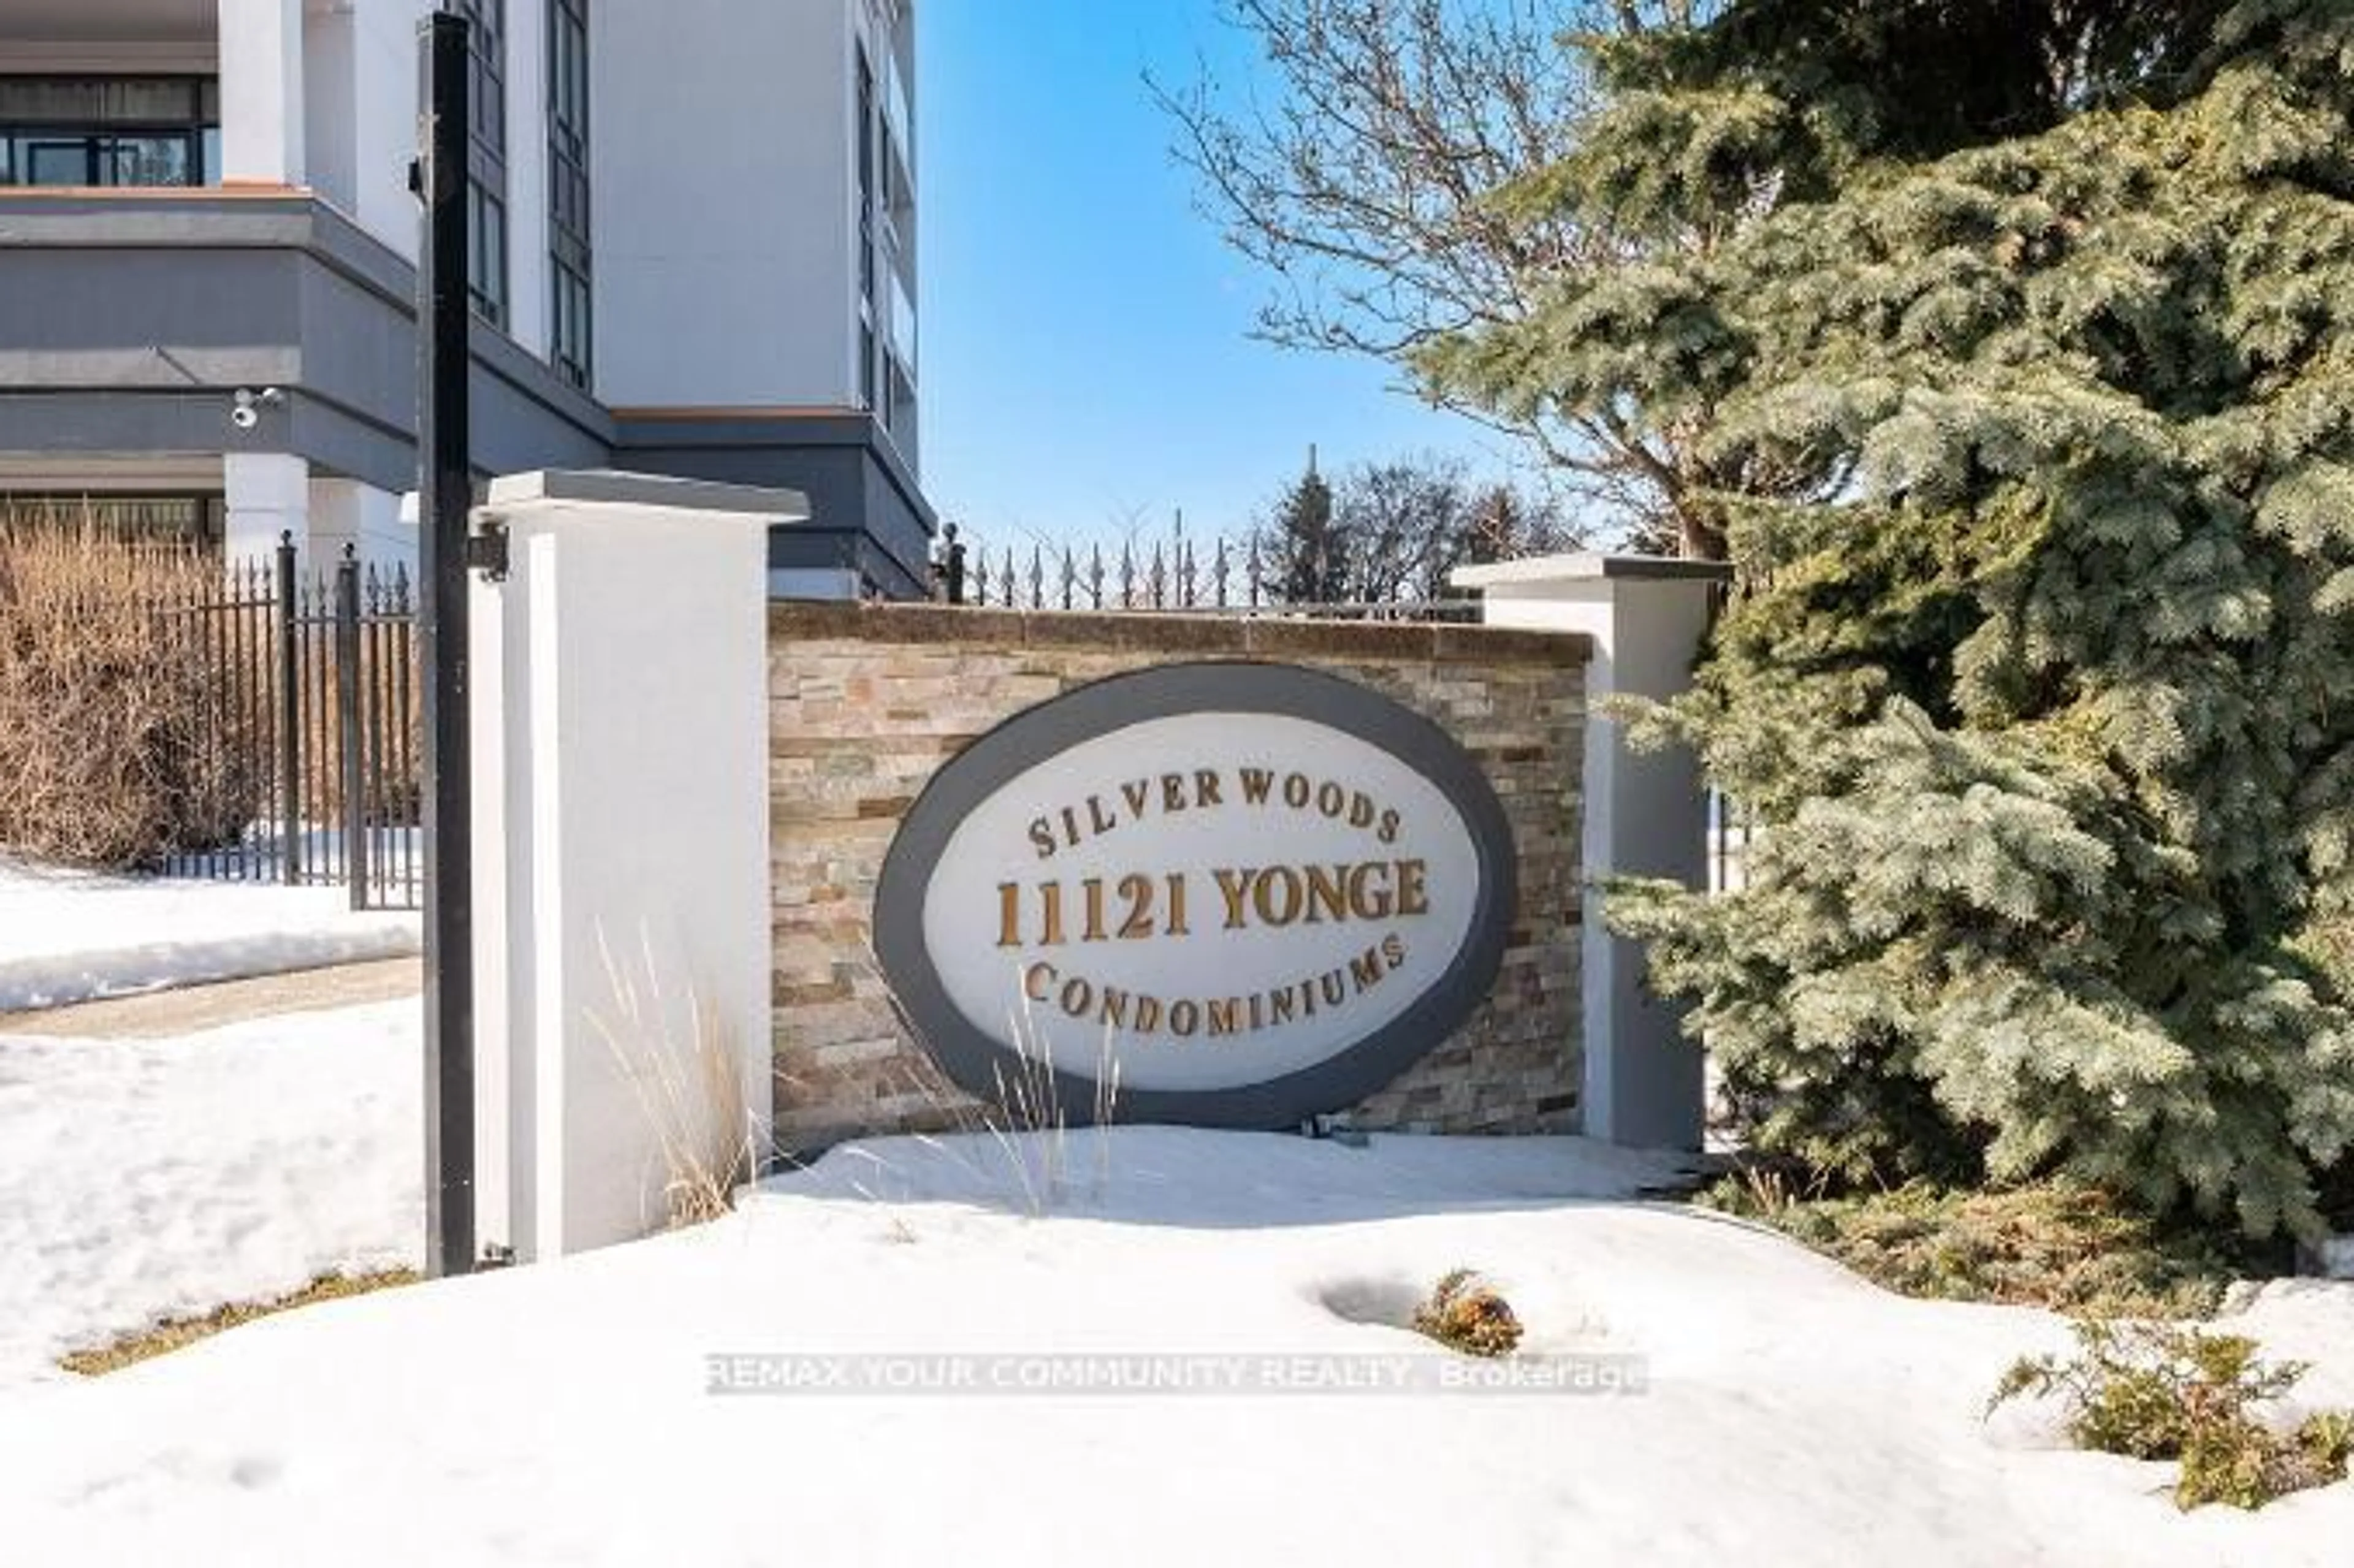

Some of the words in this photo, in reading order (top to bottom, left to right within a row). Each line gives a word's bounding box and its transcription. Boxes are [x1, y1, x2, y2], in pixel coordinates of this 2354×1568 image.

[996, 872, 1192, 948] 11121
[1213, 858, 1430, 929] YONGE
[1024, 932, 1406, 1037] CONDOMINIUMS
